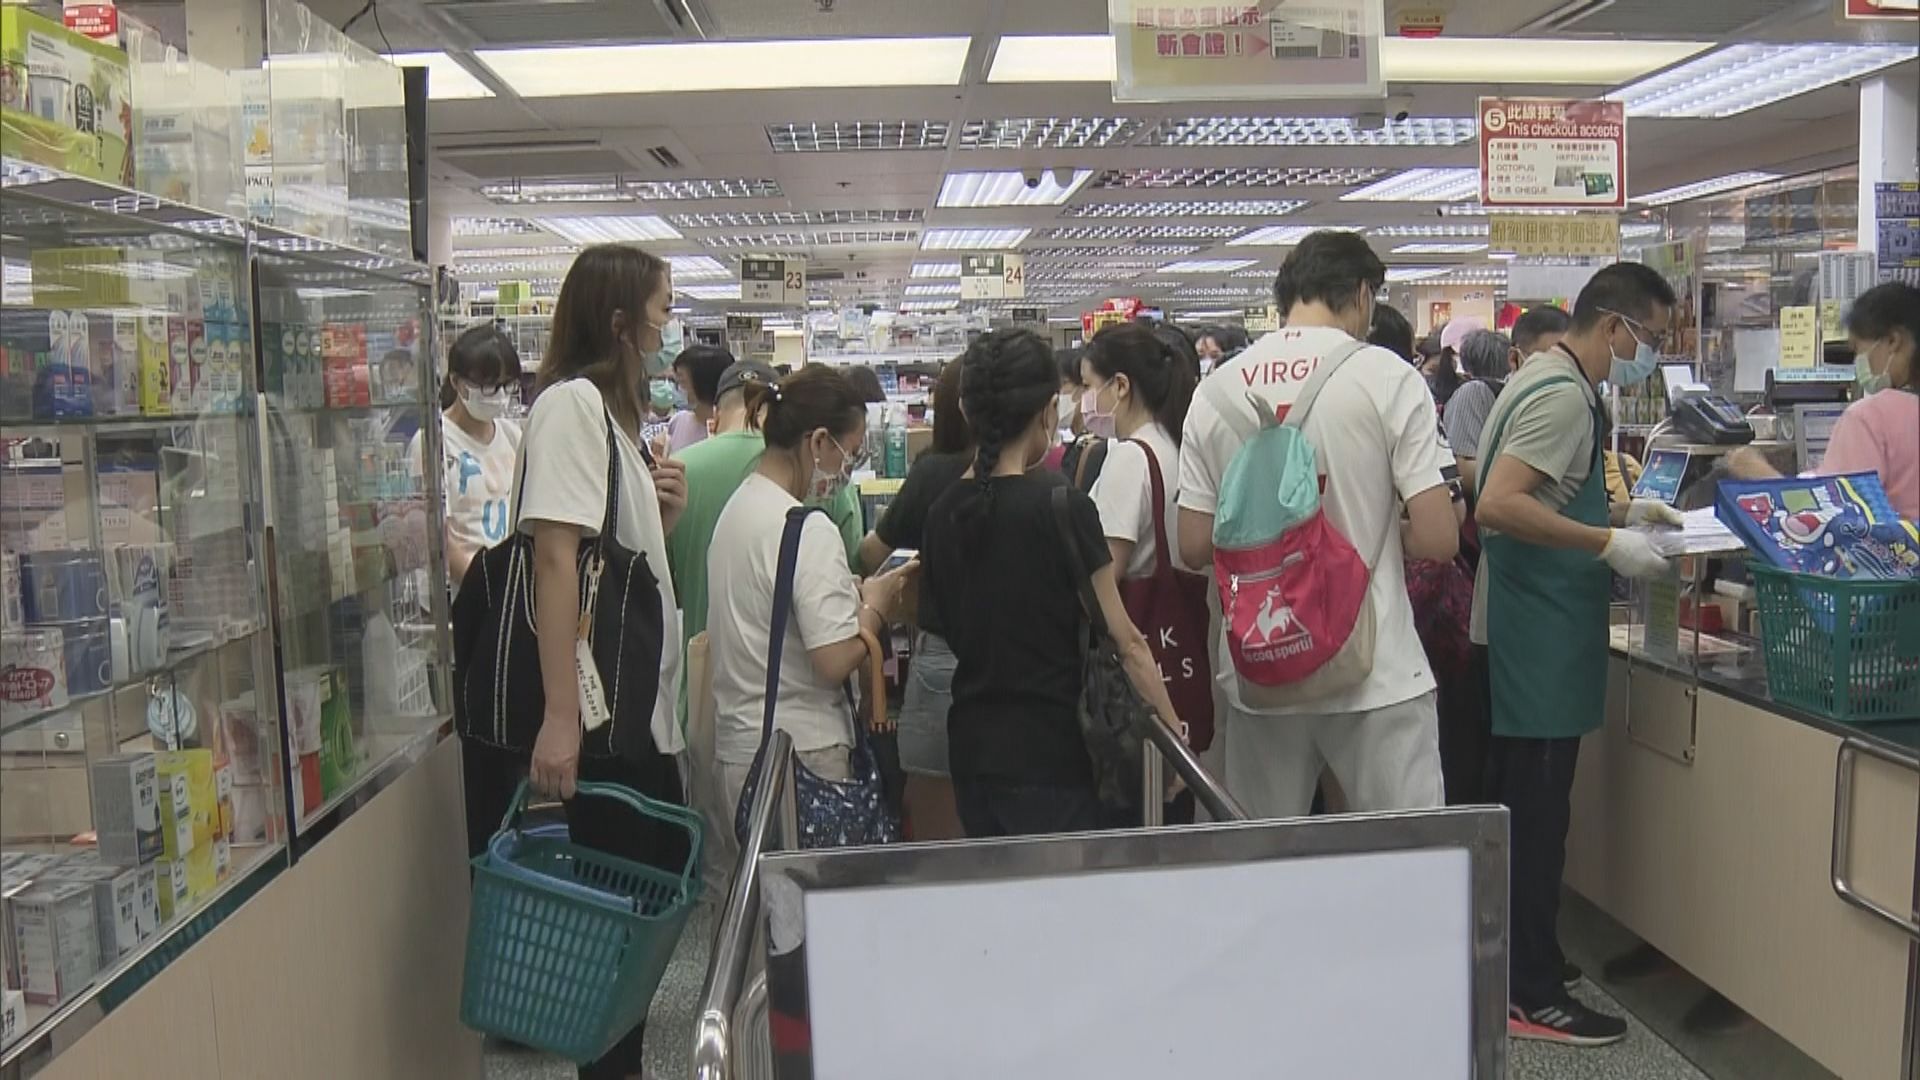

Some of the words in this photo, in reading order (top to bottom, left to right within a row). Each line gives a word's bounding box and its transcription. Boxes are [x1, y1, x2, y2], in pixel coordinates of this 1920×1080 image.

[1490, 112, 1501, 127] 5
[1508, 122, 1529, 136] This
[1531, 123, 1578, 137] checkout
[1579, 125, 1620, 138] accepts
[786, 271, 802, 289] 23
[1005, 266, 1022, 285] 24
[1241, 356, 1320, 387] VIRGI
[1253, 649, 1274, 662] coq
